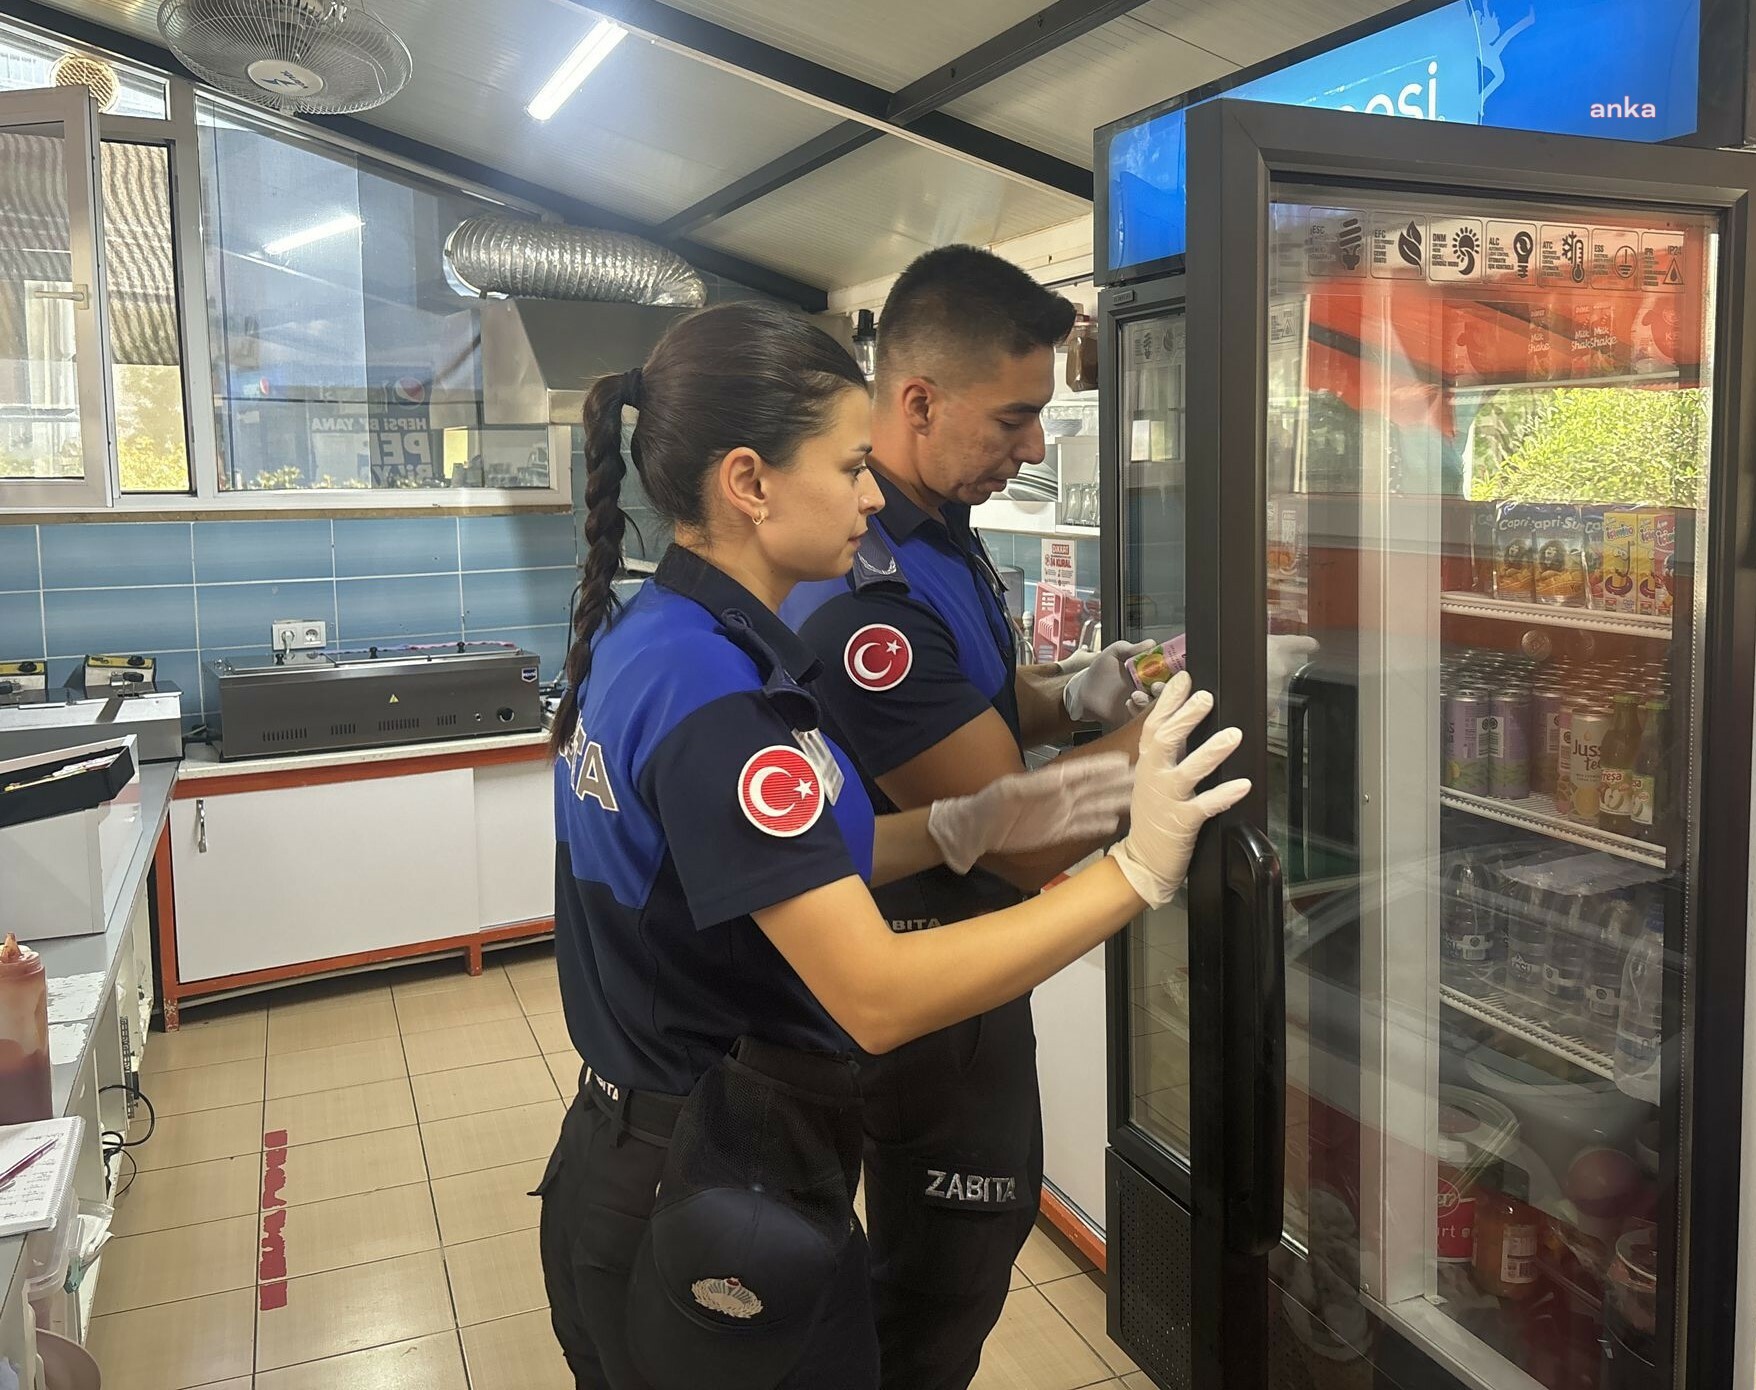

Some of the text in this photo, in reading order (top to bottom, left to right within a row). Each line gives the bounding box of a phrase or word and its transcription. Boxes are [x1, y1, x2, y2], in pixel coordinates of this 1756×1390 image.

[1374, 230, 1386, 239] EFC
[1489, 237, 1500, 246] ALC
[1542, 241, 1553, 250] ATC
[892, 918, 941, 931] BITA
[925, 1169, 1017, 1203] ZABITA
